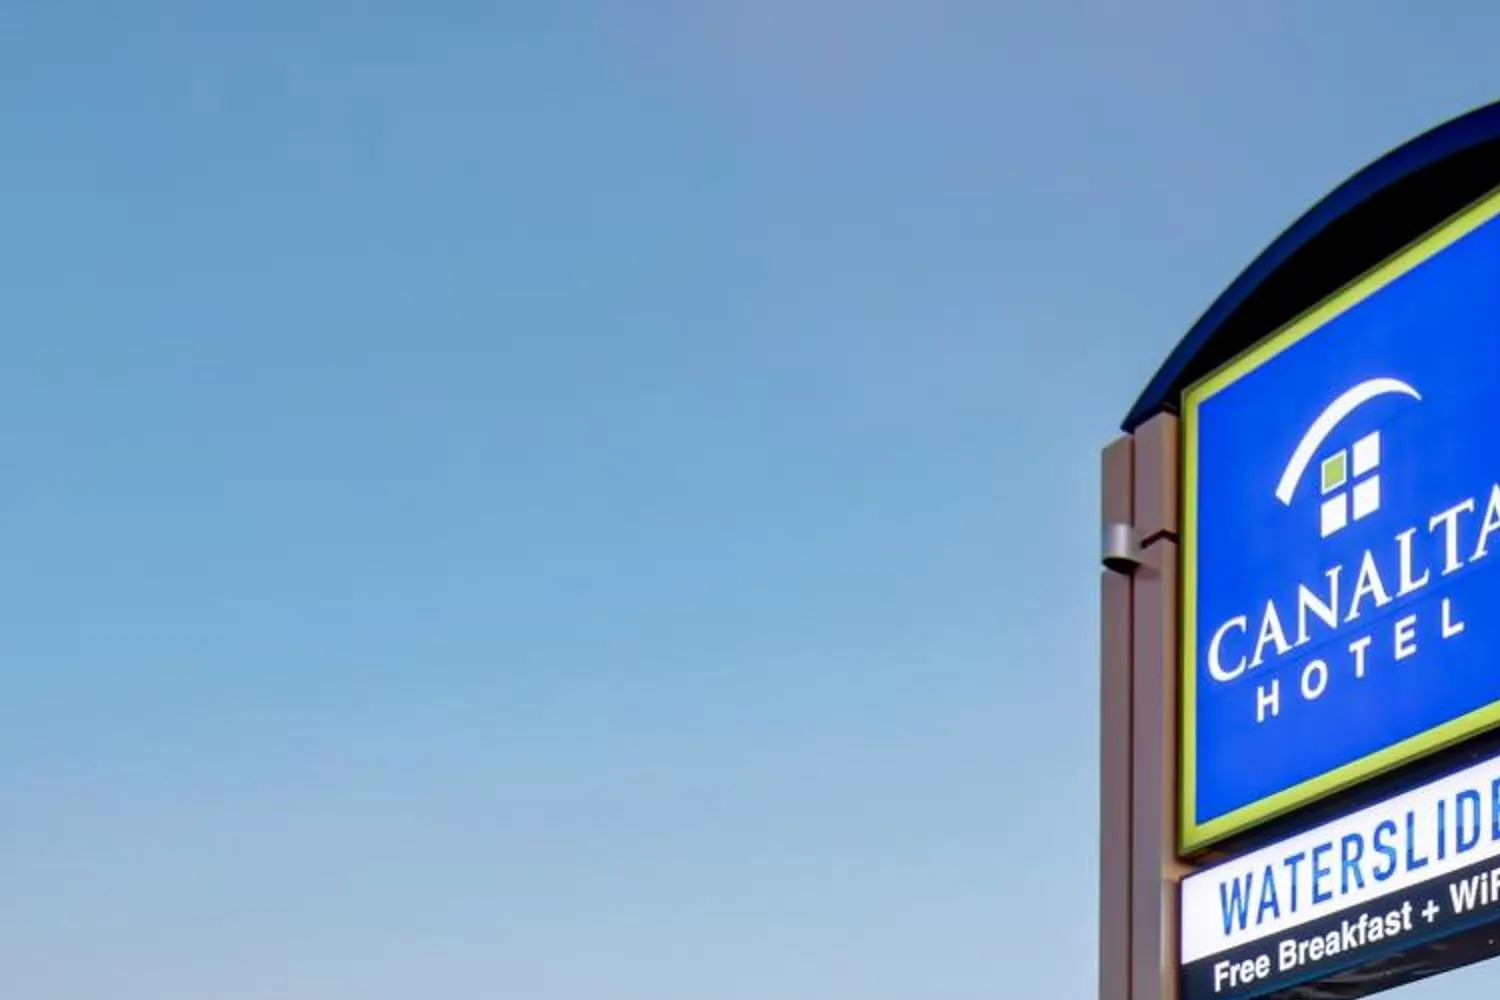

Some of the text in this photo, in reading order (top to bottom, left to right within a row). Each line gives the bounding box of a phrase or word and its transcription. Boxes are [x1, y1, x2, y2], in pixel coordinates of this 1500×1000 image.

[1256, 598, 1465, 723] HOTEL
[1213, 953, 1271, 993] Free
[1278, 902, 1413, 971] Breakfast
